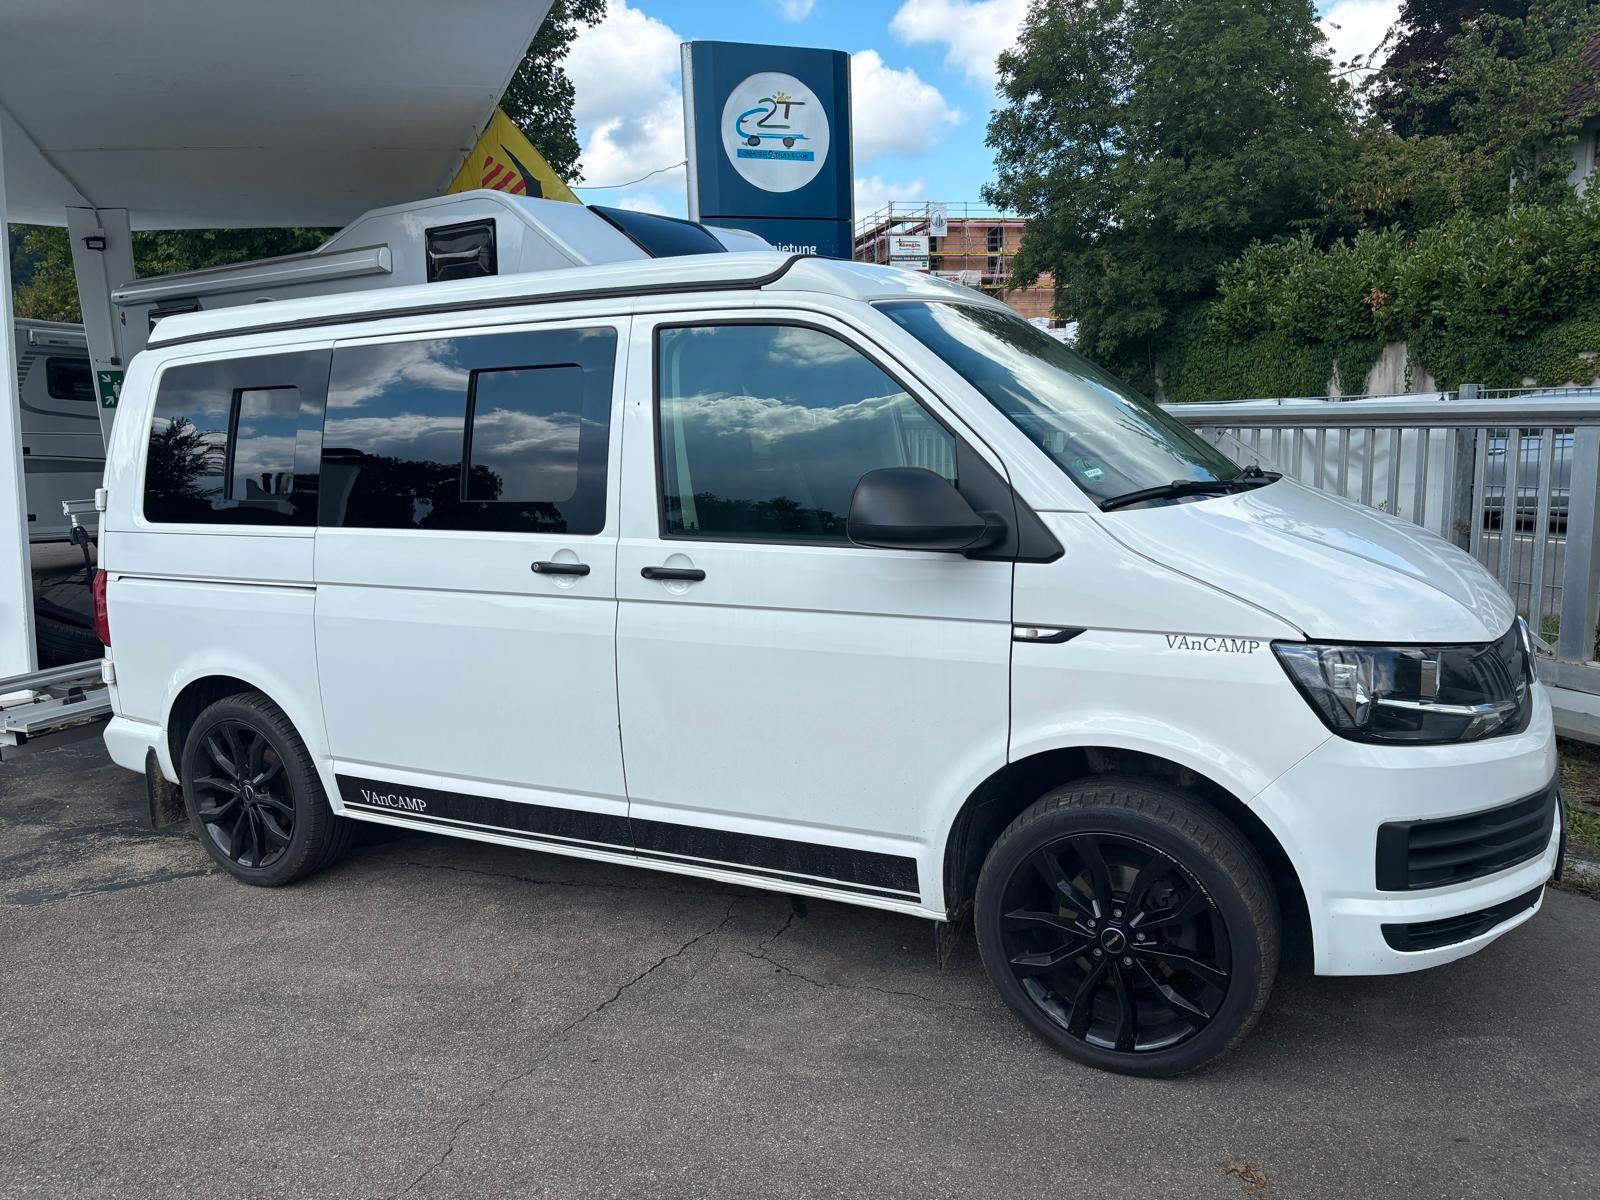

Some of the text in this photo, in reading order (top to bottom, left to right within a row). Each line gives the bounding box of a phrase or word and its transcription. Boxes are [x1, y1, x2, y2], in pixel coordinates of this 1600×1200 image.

[776, 242, 817, 256] ietung
[1165, 634, 1260, 654] VAnCAMP
[360, 789, 427, 812] VAnCAMP
